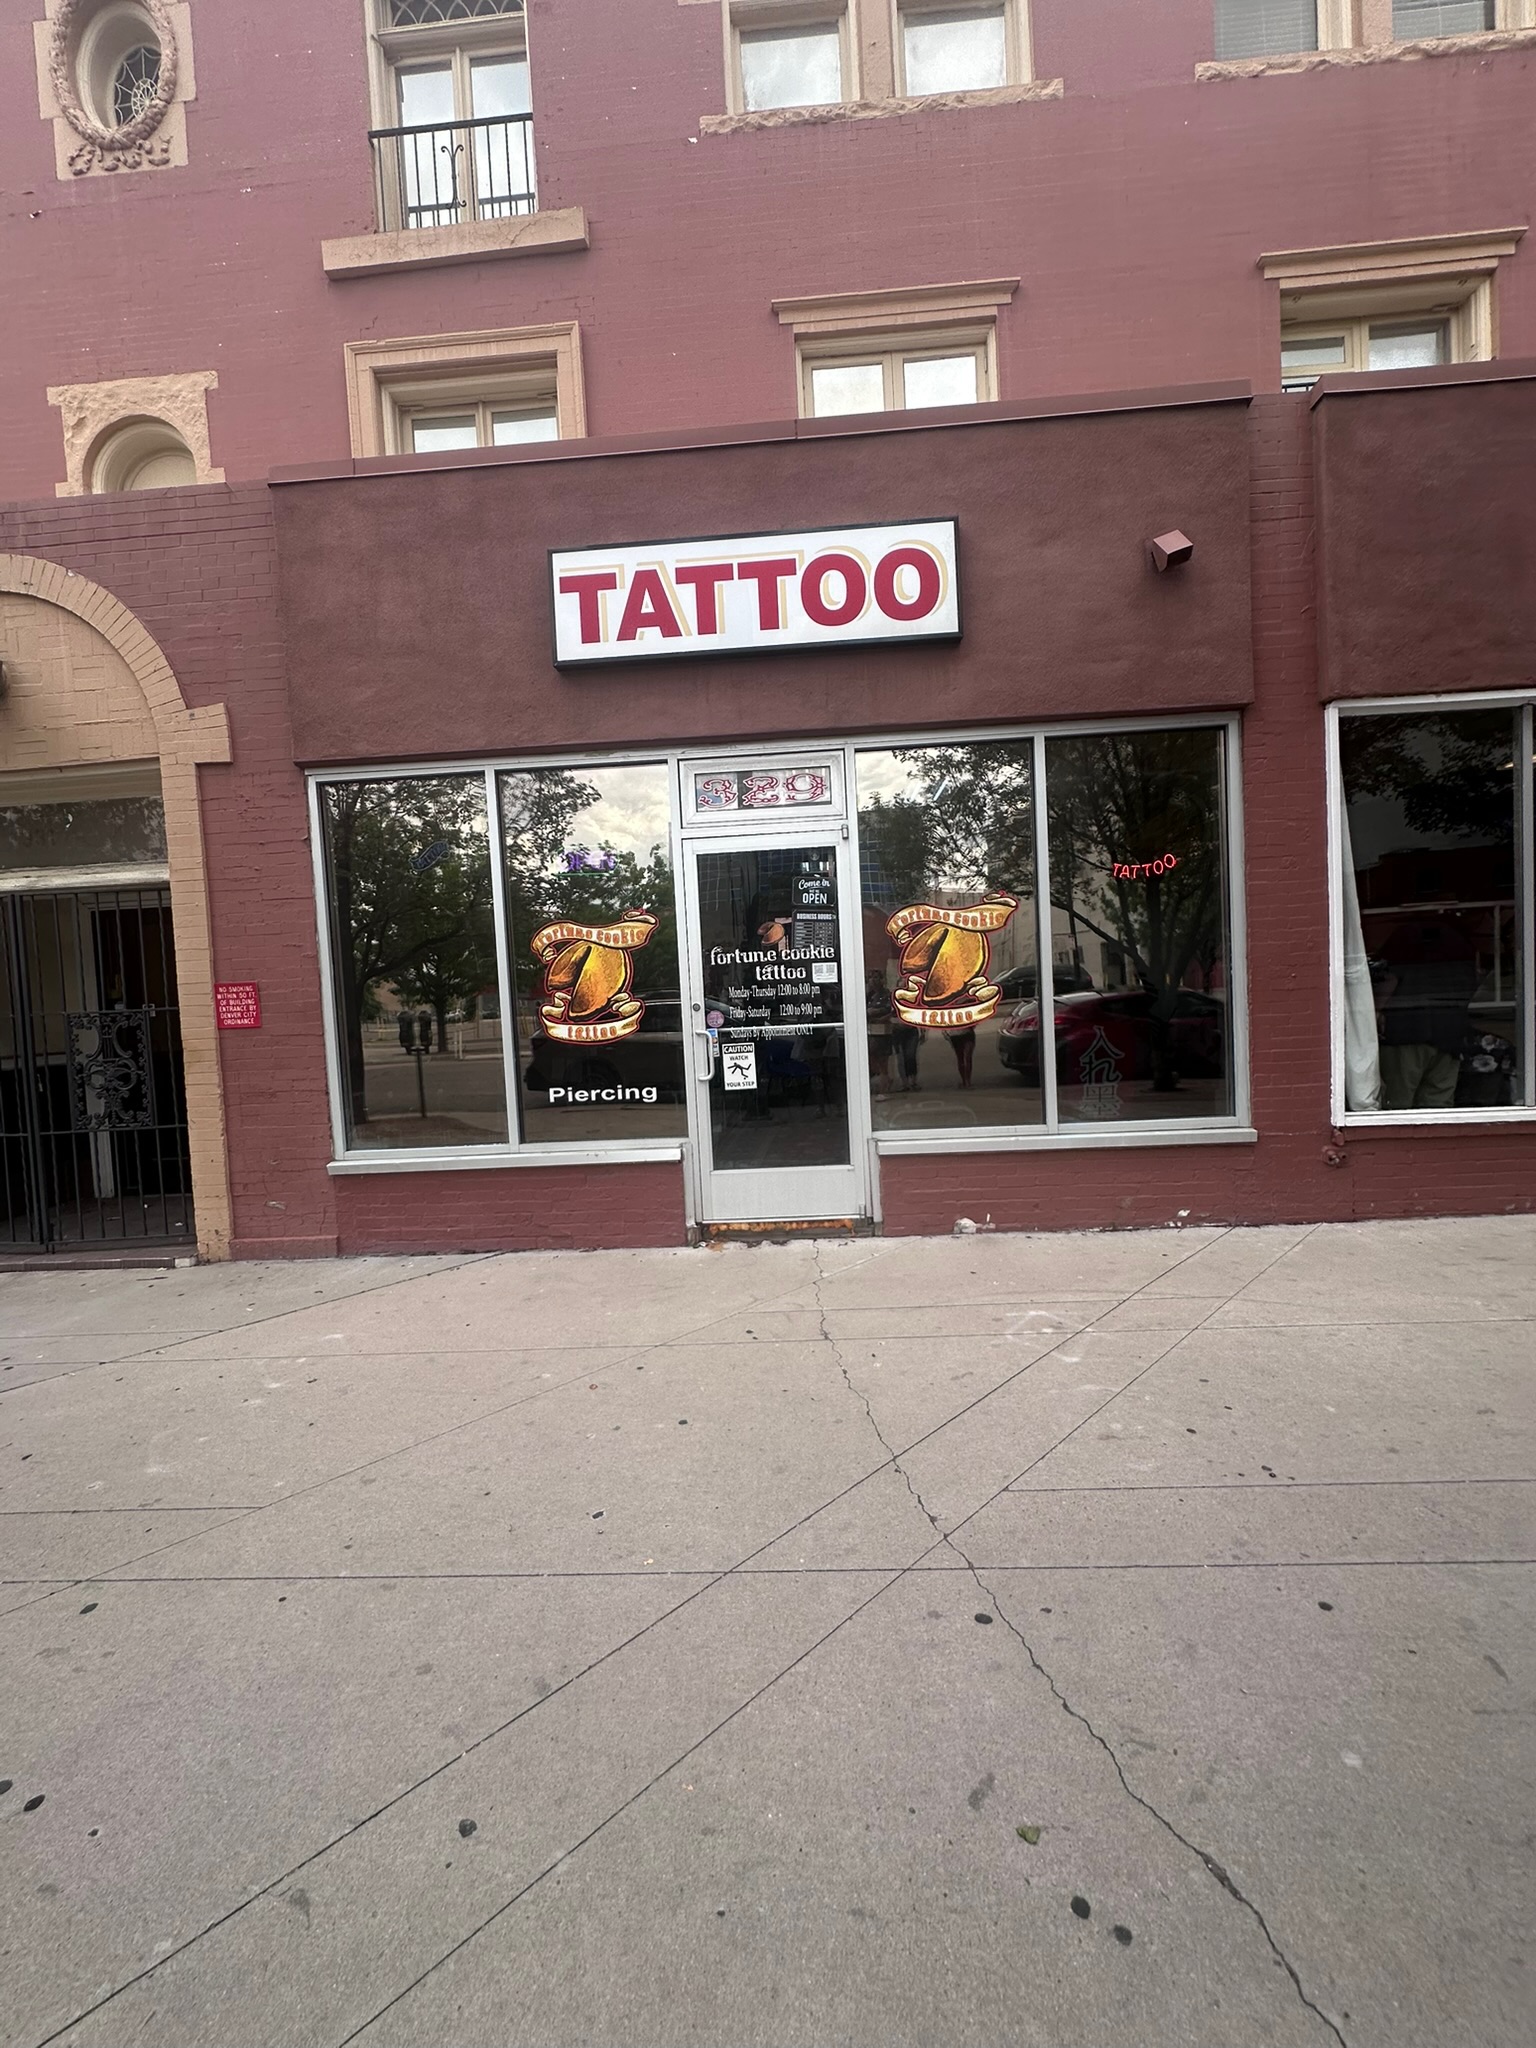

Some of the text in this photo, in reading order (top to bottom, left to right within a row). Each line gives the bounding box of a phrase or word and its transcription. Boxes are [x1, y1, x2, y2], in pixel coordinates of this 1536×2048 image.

[558, 541, 948, 645] TATTOO
[1113, 853, 1176, 879] TATTOO
[798, 878, 831, 890] Come in
[802, 892, 828, 904] OPEN
[710, 944, 835, 966] fortune cookie
[755, 963, 807, 981] tattoo
[228, 985, 253, 993] SMOKING
[728, 982, 821, 1001] Monday-Thursday 12:00 to 8:00 pm
[229, 998, 255, 1006] BUILDING
[729, 1004, 771, 1021] Friday-Saturday
[779, 1004, 795, 1016] 12:00
[794, 1004, 801, 1015] to
[801, 1003, 813, 1015] 9:00
[813, 1005, 823, 1018] pm
[724, 1045, 753, 1053] CAUTION
[742, 1080, 755, 1088] STEP
[548, 1084, 658, 1103] Piercing
